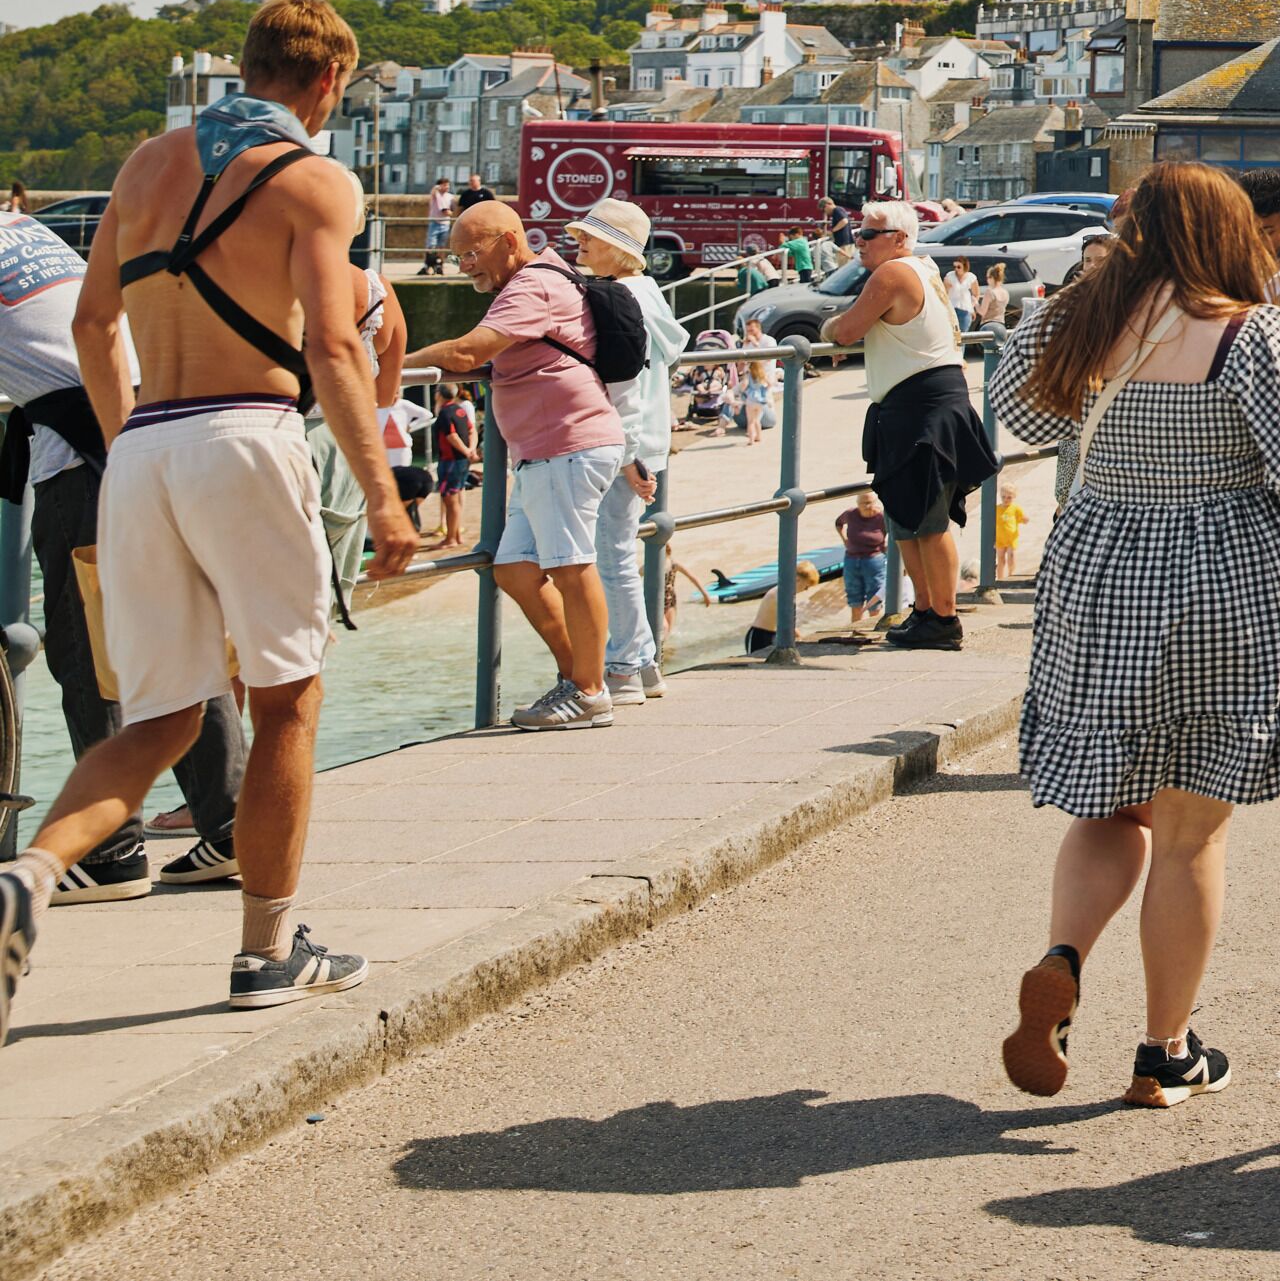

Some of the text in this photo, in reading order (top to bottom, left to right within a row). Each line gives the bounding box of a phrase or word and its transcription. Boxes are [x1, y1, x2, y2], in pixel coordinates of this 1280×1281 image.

[556, 174, 605, 183] STONED
[0, 256, 19, 269] ESTD
[18, 275, 40, 289] ST.
[39, 265, 66, 279] IVES
